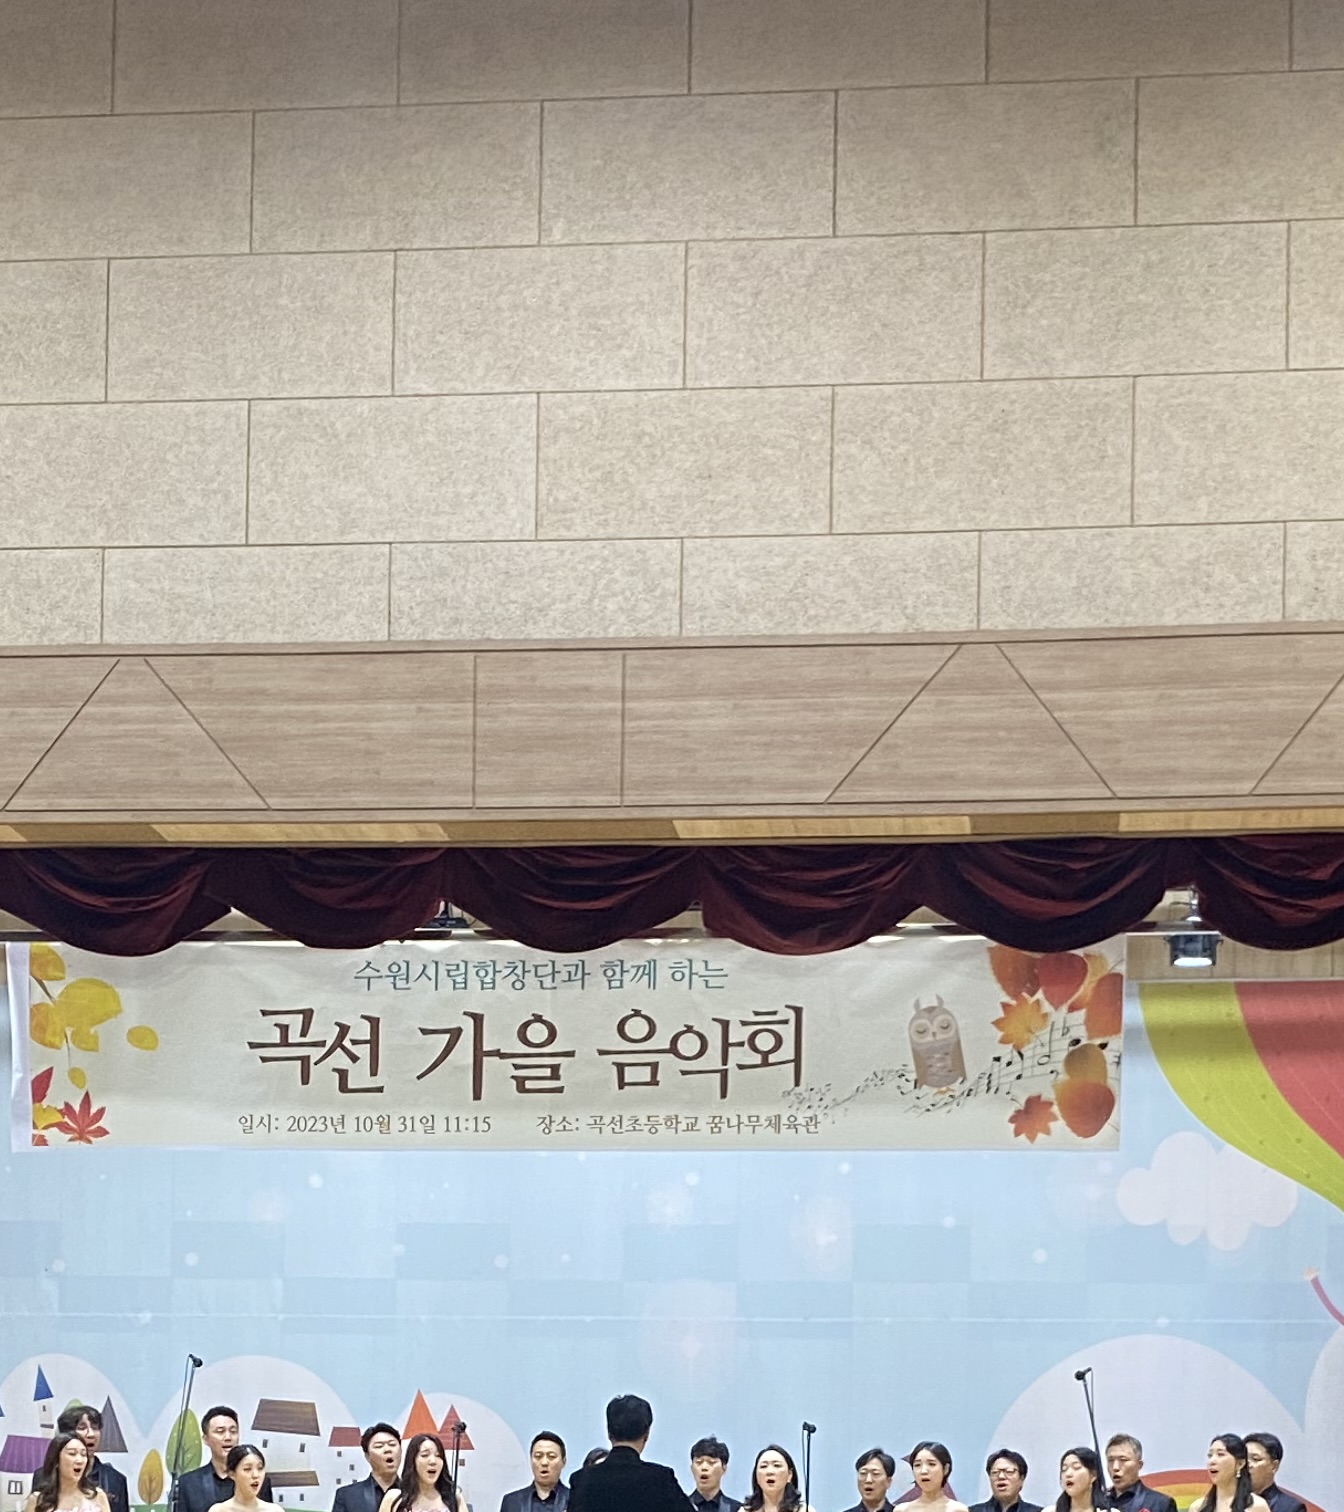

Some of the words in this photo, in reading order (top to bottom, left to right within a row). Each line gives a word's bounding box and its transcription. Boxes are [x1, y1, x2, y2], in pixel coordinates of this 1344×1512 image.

[353, 959, 591, 991] 수원시립합창단과
[601, 959, 657, 991] 함께
[667, 959, 729, 990] 하는
[247, 1007, 384, 1094] 곡선
[416, 1010, 576, 1101] 가을
[596, 1003, 803, 1100] 음악회
[238, 1114, 280, 1135] 일시:
[286, 1114, 347, 1134] 2023년
[354, 1114, 392, 1135] 10월
[397, 1114, 436, 1135] 31일
[444, 1115, 492, 1134] 11:15
[536, 1114, 579, 1135] 장소:
[586, 1114, 701, 1135] 곡선초등학교
[706, 1114, 821, 1135] 꿈나무체육관
